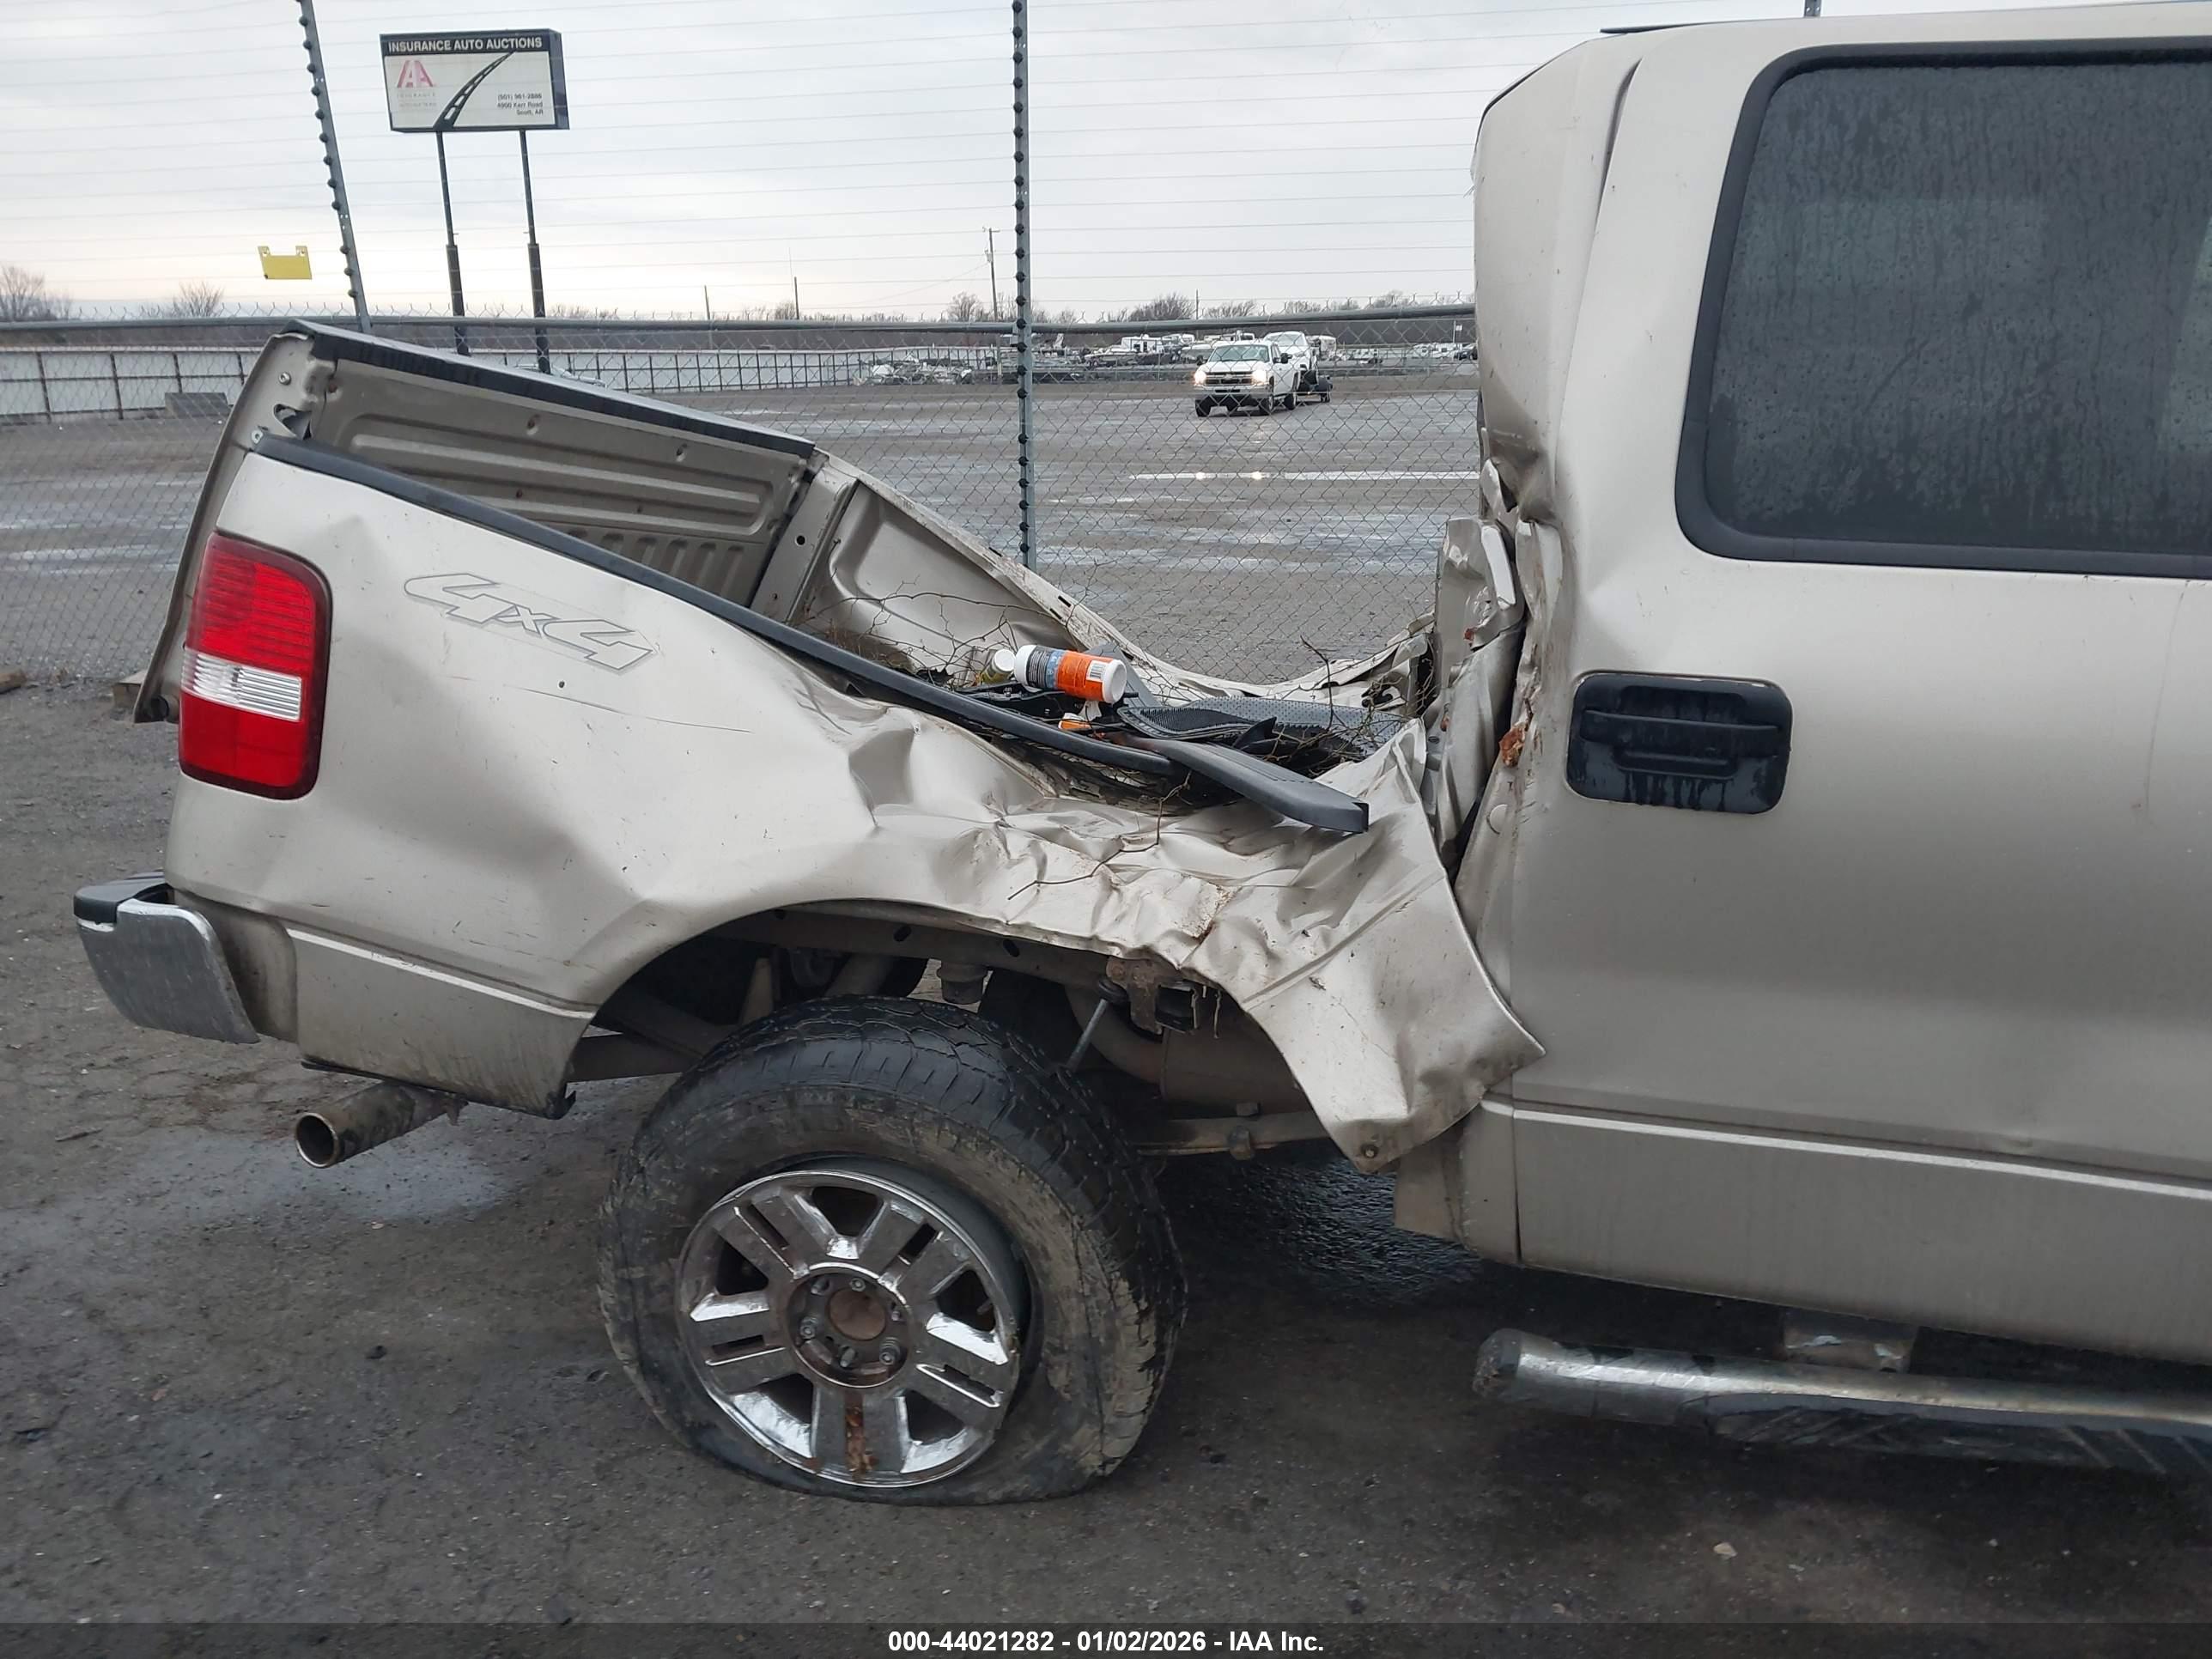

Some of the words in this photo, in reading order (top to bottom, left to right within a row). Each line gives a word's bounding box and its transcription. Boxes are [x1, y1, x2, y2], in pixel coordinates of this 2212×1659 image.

[388, 40, 452, 52] INSURANCE
[453, 39, 484, 51] AUTO
[486, 37, 543, 50] AUCTIONS
